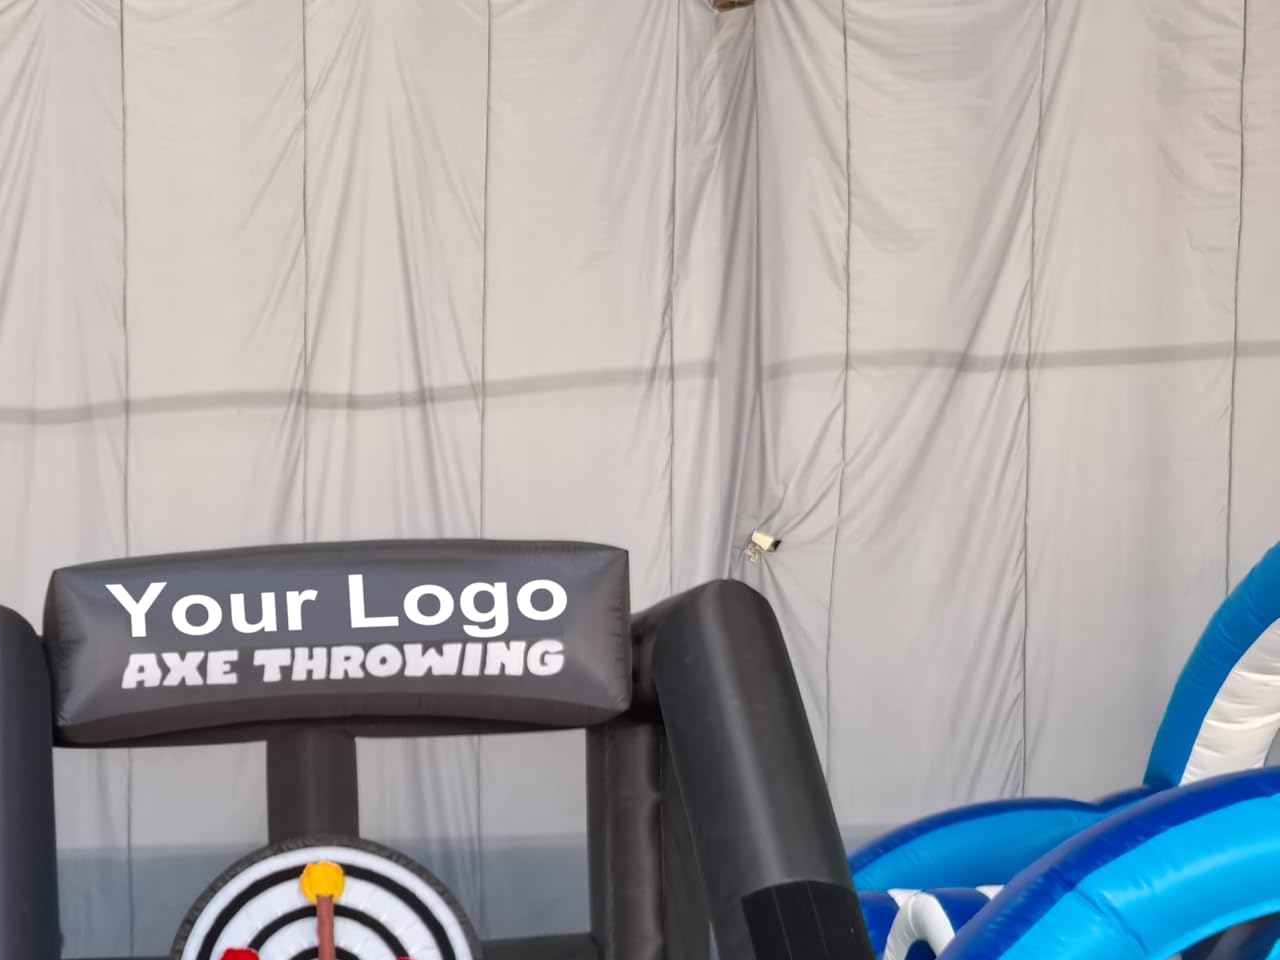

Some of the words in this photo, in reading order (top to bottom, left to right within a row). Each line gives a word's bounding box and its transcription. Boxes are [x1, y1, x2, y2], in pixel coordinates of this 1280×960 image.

[105, 581, 318, 638] Your
[347, 573, 568, 638] Logo
[121, 648, 238, 689] AXE
[253, 639, 565, 683] THROWING
